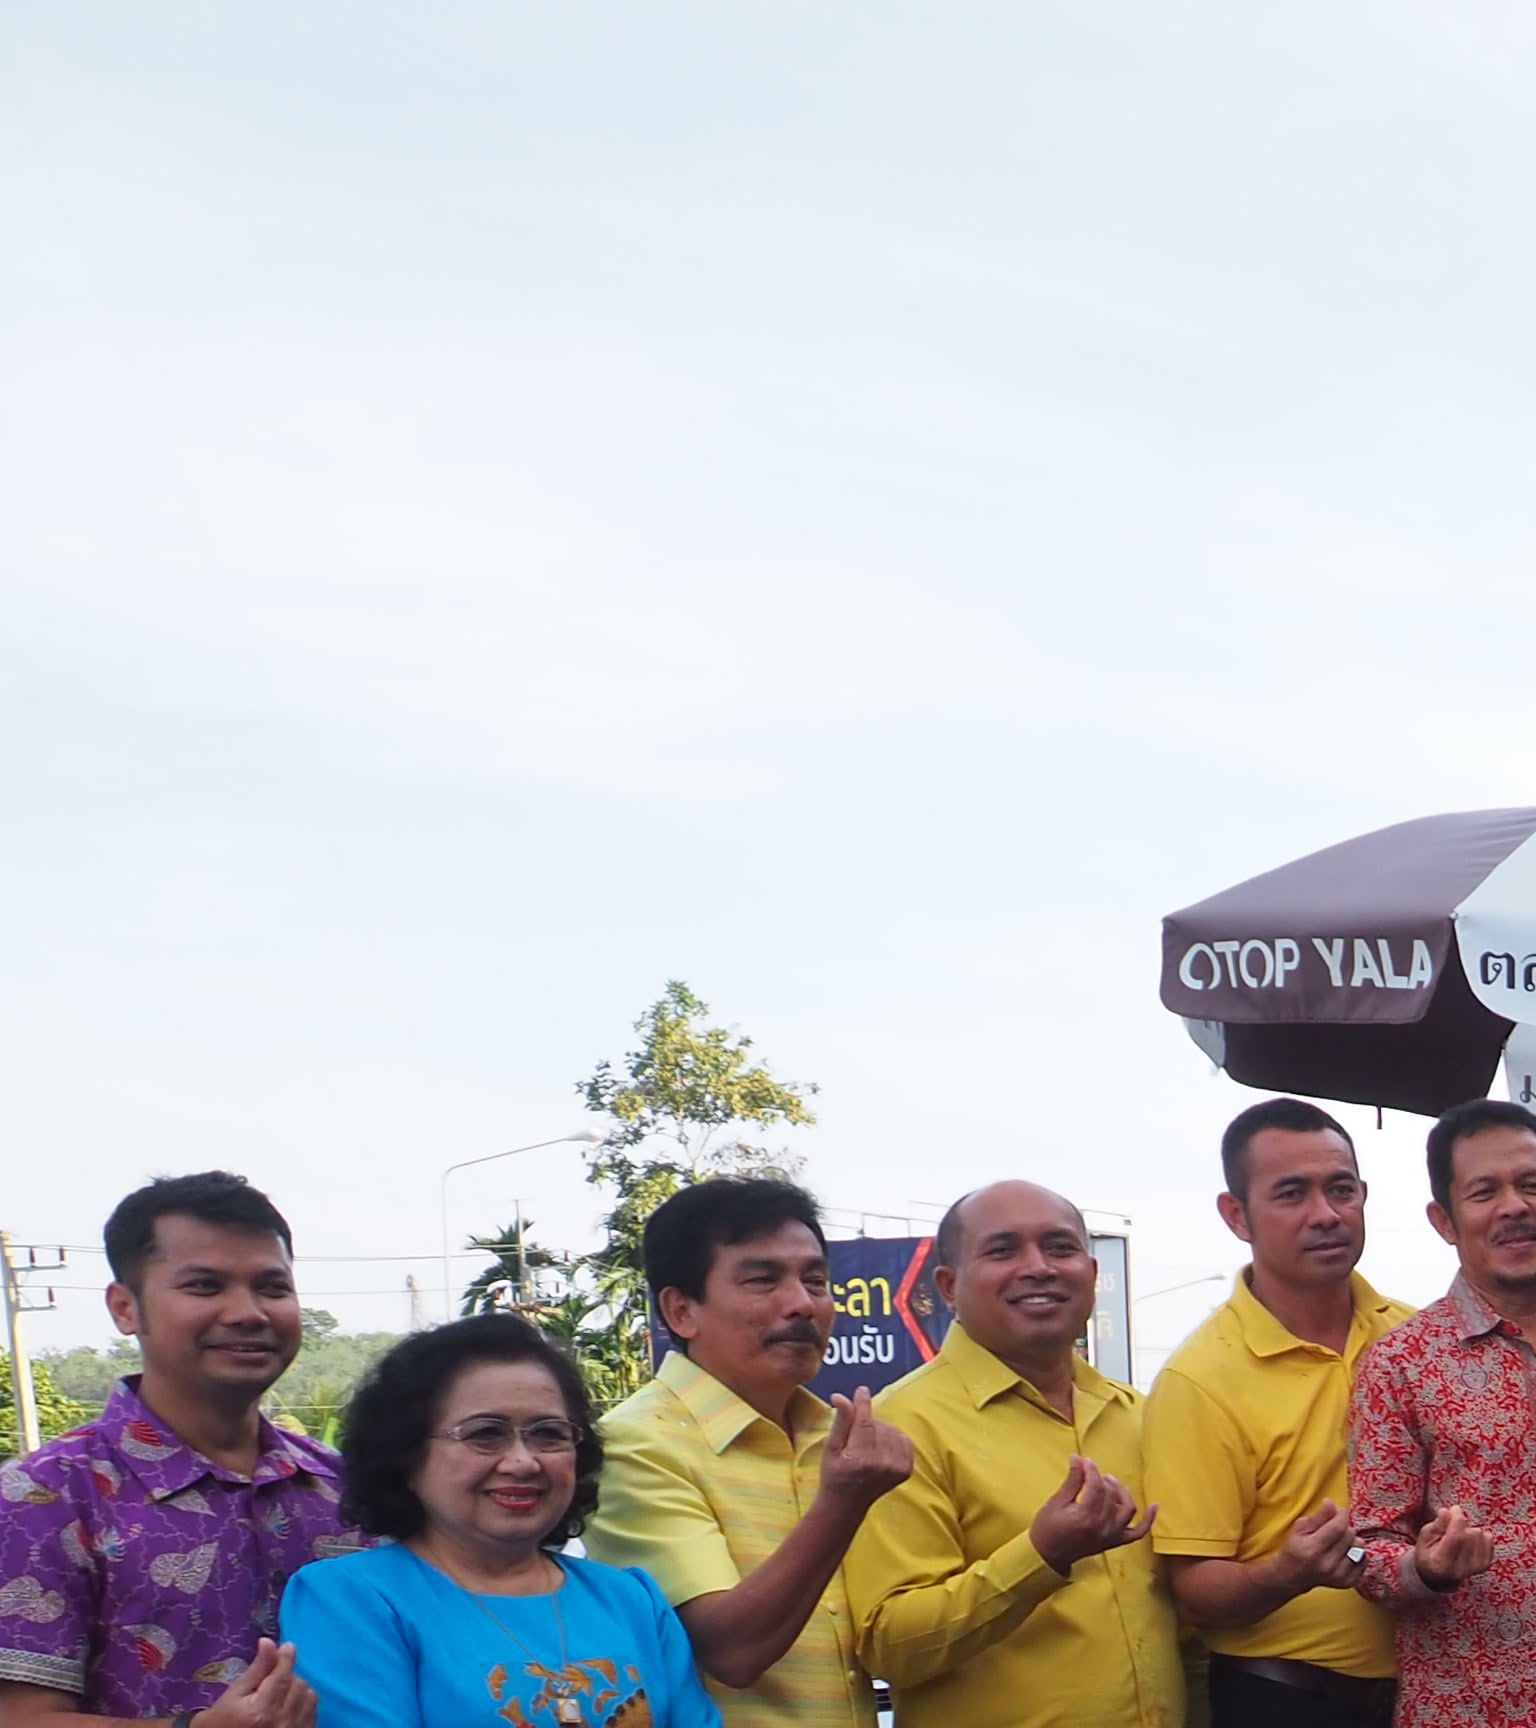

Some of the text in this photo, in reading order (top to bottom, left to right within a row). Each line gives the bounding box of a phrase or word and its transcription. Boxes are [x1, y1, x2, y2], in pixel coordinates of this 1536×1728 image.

[1178, 937, 1434, 991] OTOP YALA
[827, 1277, 891, 1317] ะลา
[823, 1324, 894, 1365] อนรับ
